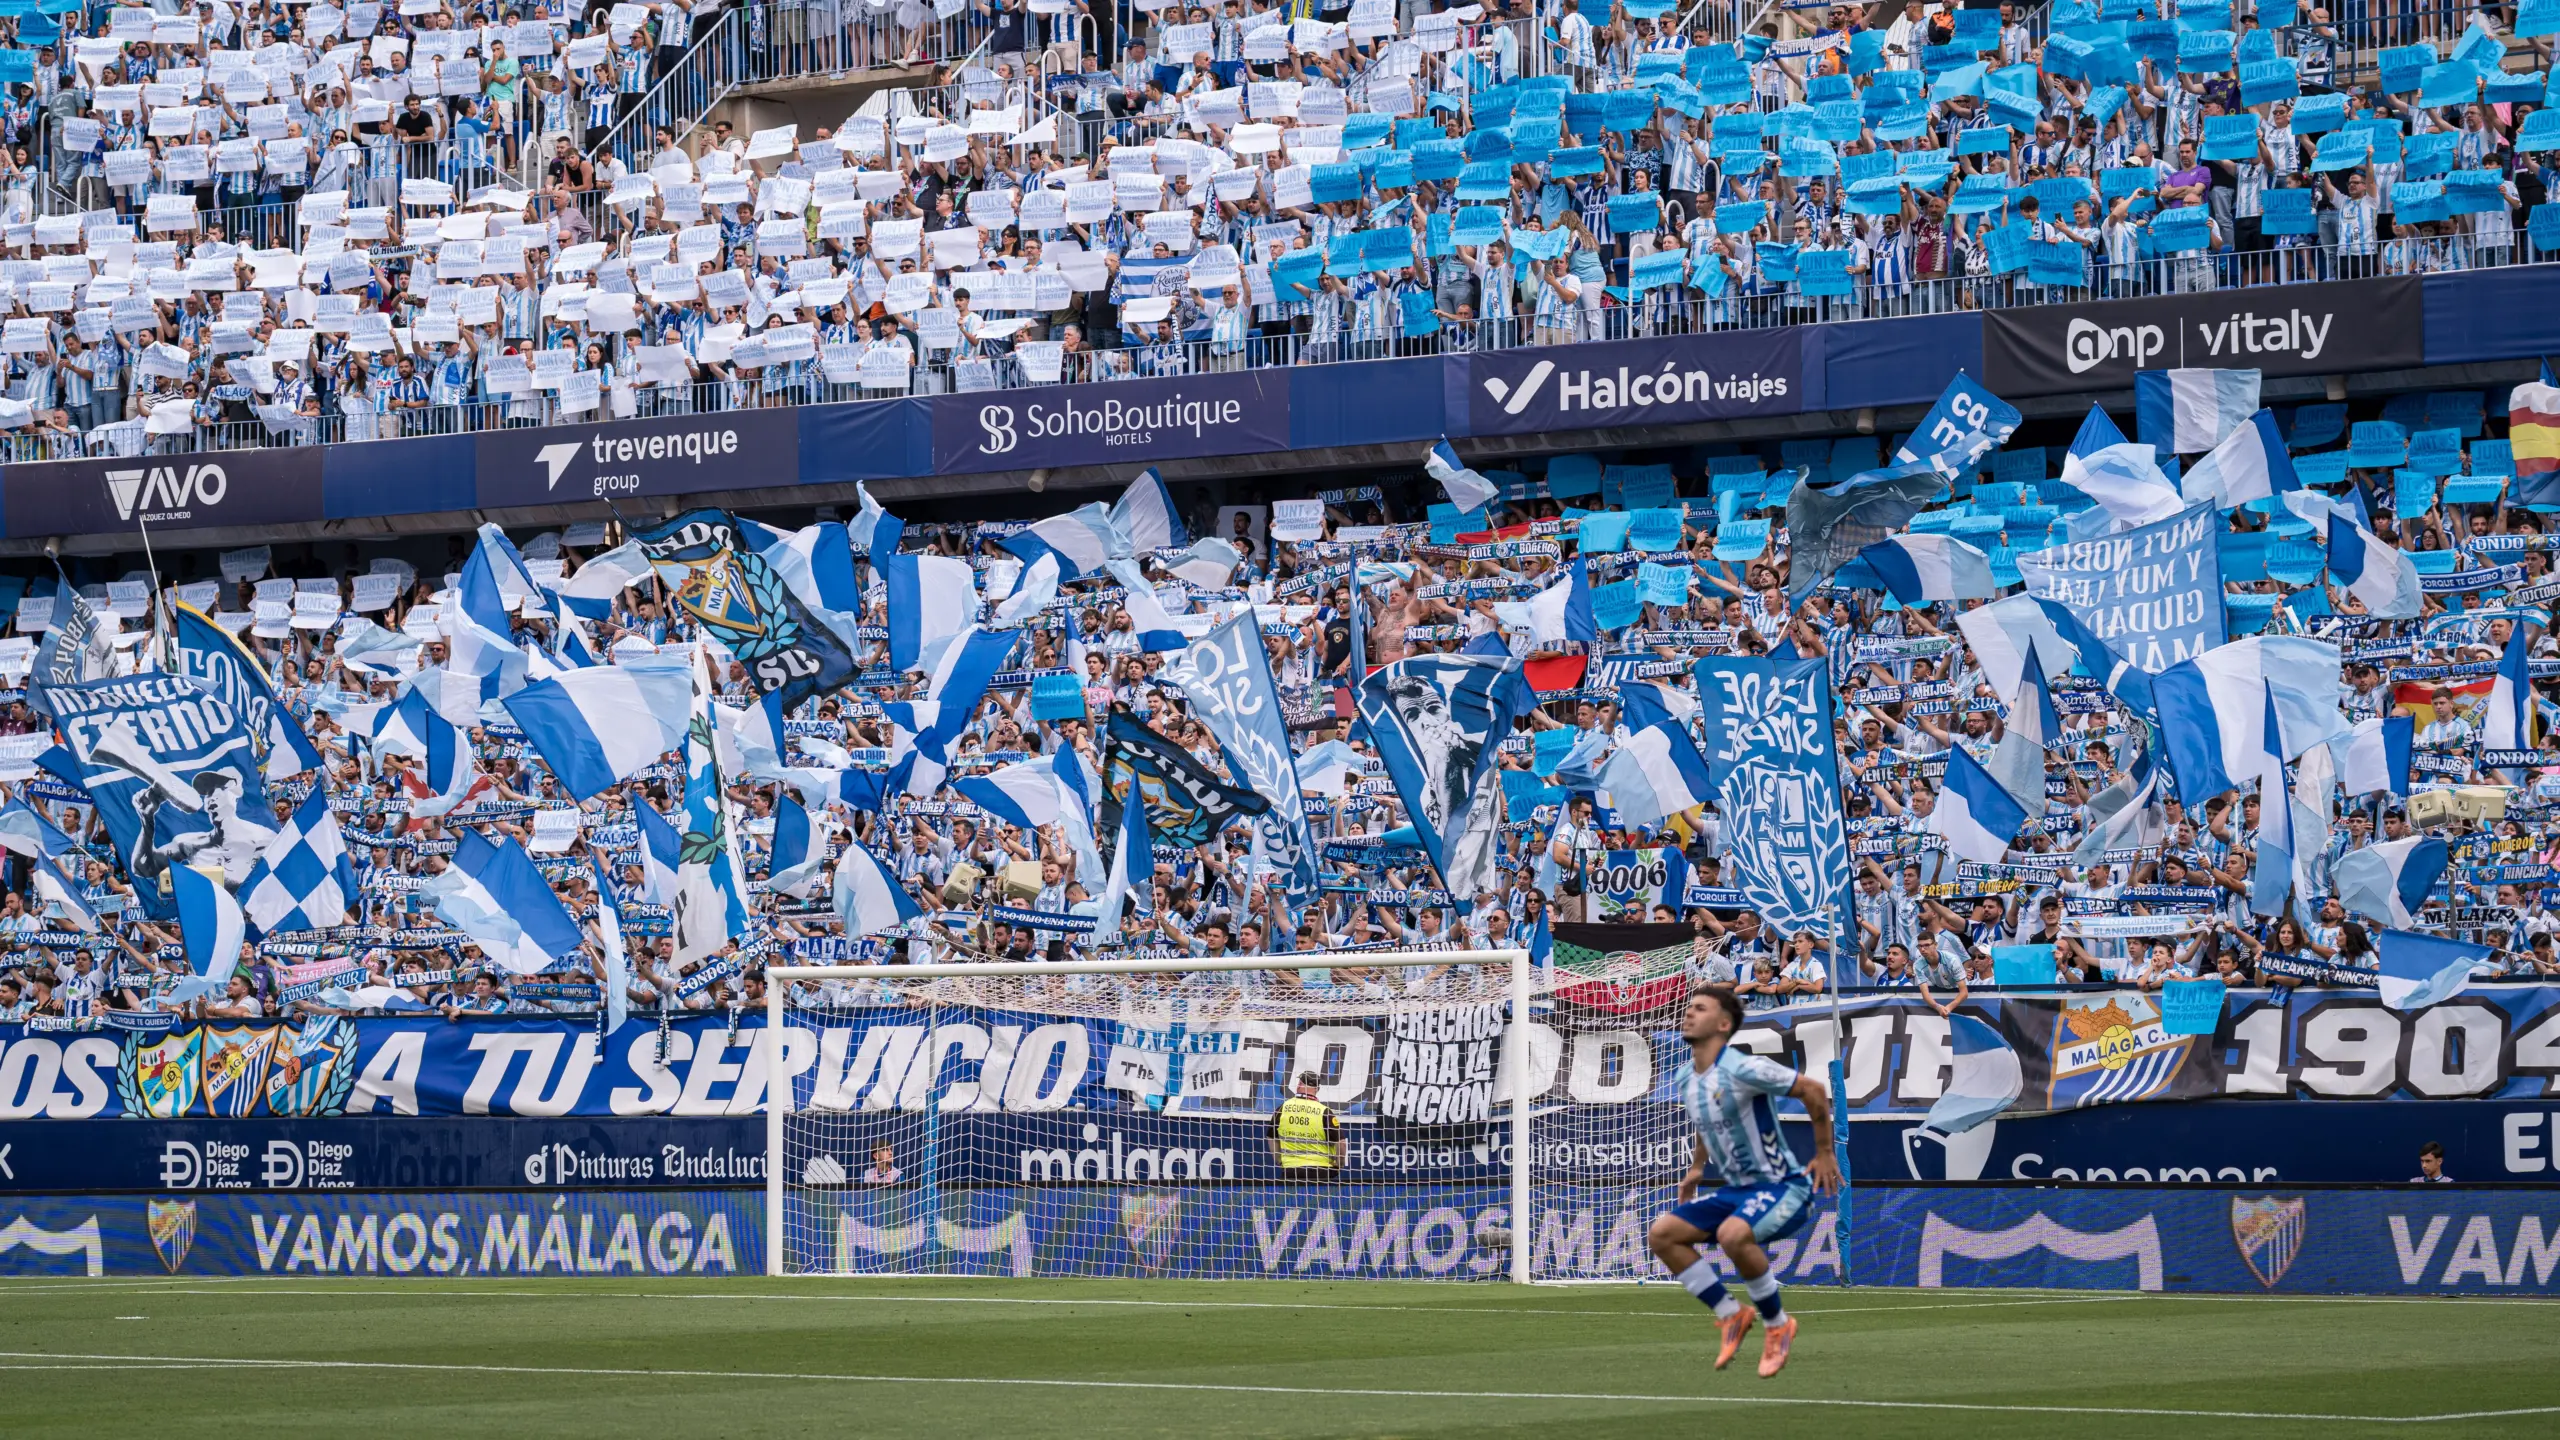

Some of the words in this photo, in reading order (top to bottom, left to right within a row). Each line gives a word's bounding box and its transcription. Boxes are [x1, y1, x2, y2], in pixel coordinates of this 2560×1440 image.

[1560, 362, 1710, 411] Halcón
[1714, 372, 1788, 403] viajes
[1027, 394, 1240, 438] SohoBoutique
[1106, 431, 1152, 446] HOTELS
[592, 430, 738, 464] trevenque
[593, 473, 640, 495] group
[166, 511, 191, 521] OLMEDO
[2468, 571, 2499, 584] QUIERO
[1637, 662, 1682, 678] FONDO
[2453, 661, 2500, 674] BOKE
[1860, 688, 1901, 702] PADRES
[909, 802, 947, 815] PADRES
[591, 831, 639, 846] MALAG
[2503, 865, 2550, 881] HINCHAS
[1695, 892, 1725, 902] PORQUE
[1728, 893, 1737, 901] TE
[2093, 924, 2175, 936] BLANQUIAZULES
[263, 943, 318, 956] FONDO
[397, 970, 452, 985] FONDO
[679, 961, 728, 992] FONDO
[281, 983, 321, 1002] FONDO
[334, 972, 360, 990] SUR
[31, 1018, 73, 1032] FONDO
[145, 1018, 171, 1026] QUIERO
[1121, 1026, 1236, 1055] MALAGA
[2071, 1031, 2144, 1067] MALAGA
[344, 1032, 426, 1116] A
[463, 1032, 604, 1116] TU
[610, 1023, 1088, 1116] SERVICIO
[1121, 1060, 1155, 1081] The
[1283, 1104, 1322, 1116] SEGURIDAD
[1288, 1116, 1310, 1127] 0068
[206, 1140, 250, 1160] Diego
[308, 1140, 353, 1160] Diego
[1347, 1136, 1459, 1170] Hospital
[206, 1159, 240, 1177] Díaz
[308, 1159, 342, 1177] Díaz
[478, 1195, 737, 1273] MÁLAGA
